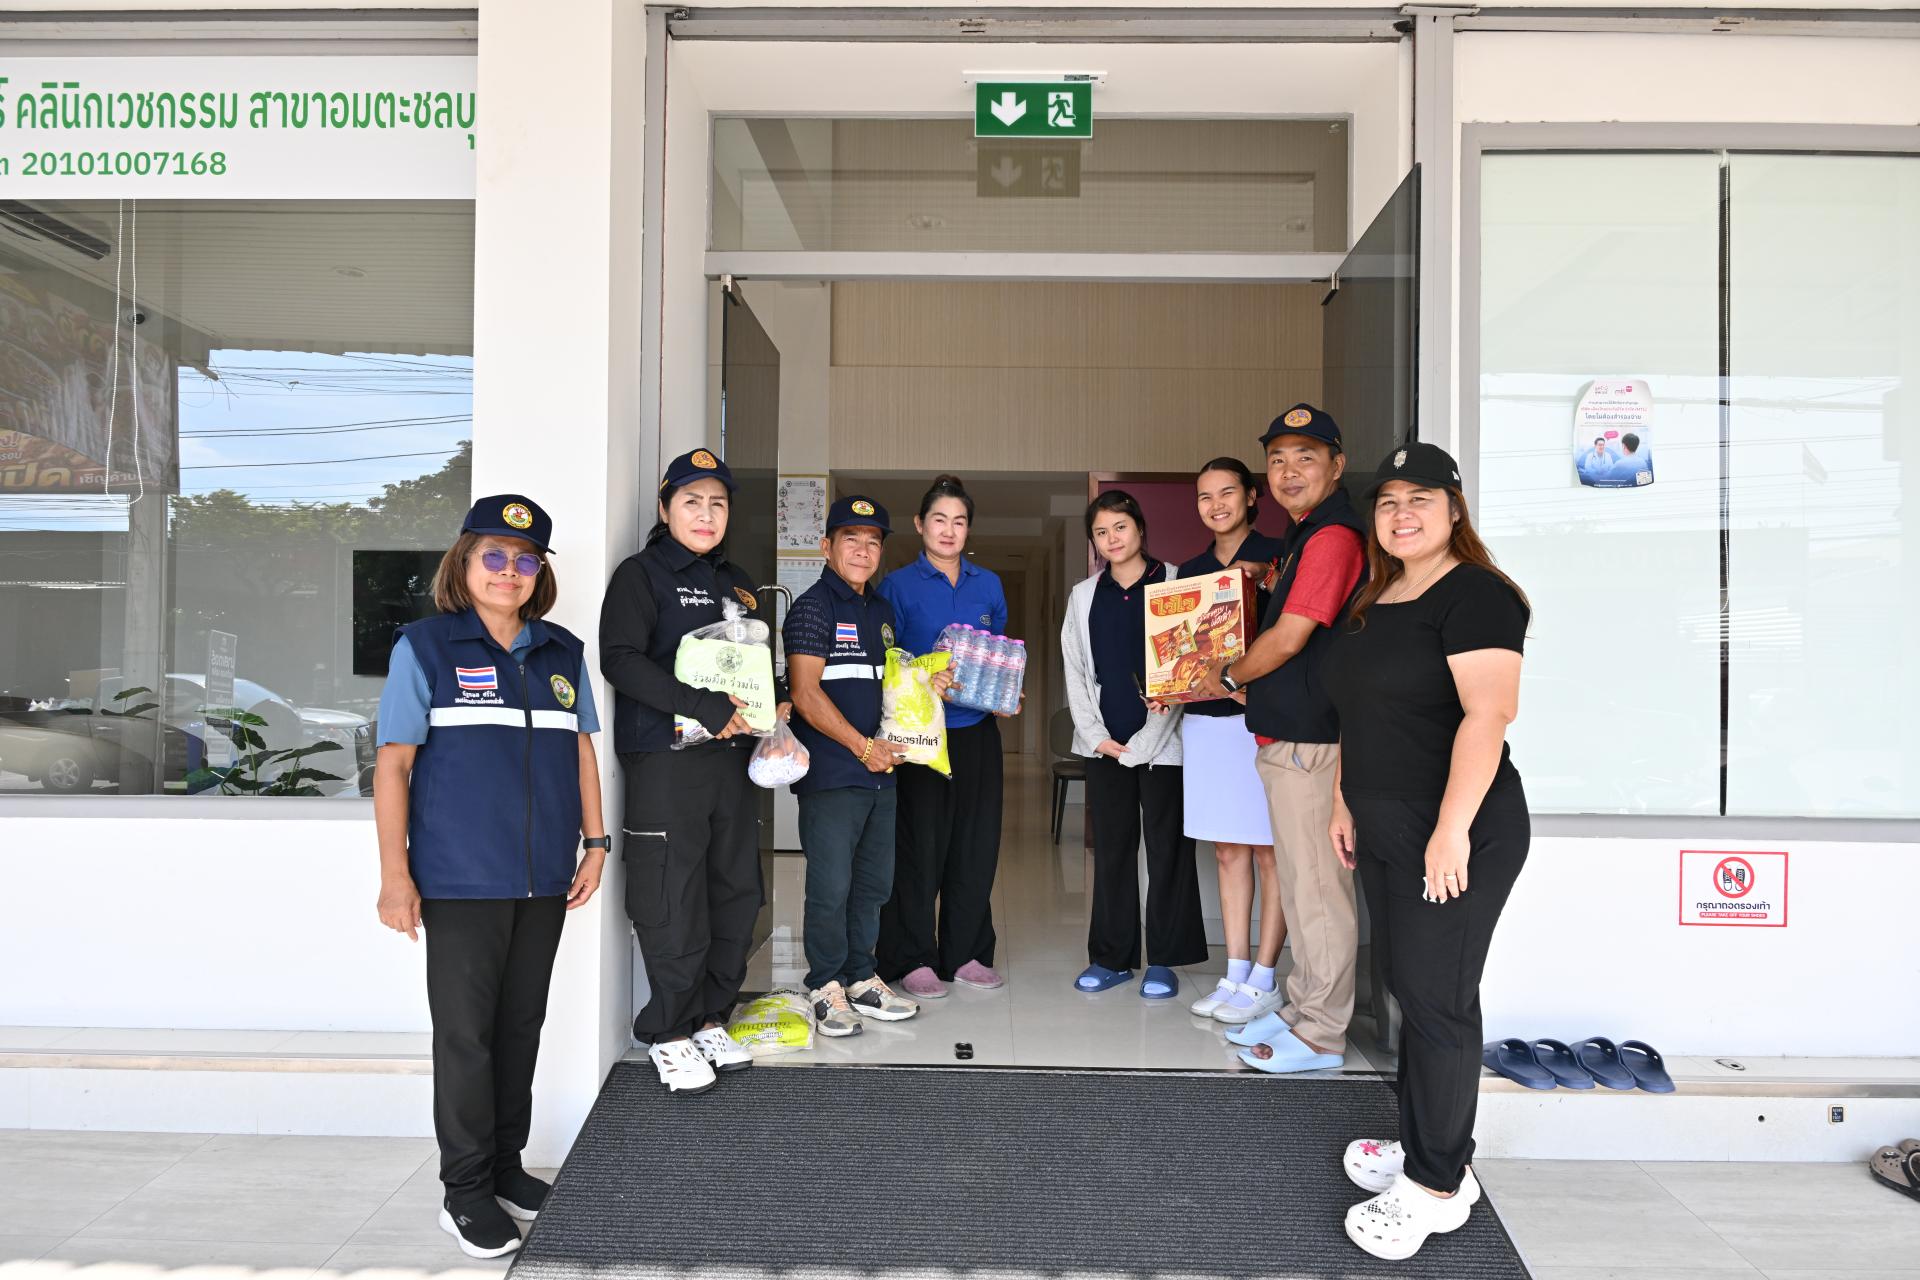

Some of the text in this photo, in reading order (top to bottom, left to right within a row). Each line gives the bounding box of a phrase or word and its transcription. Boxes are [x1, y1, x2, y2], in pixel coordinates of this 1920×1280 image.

[17, 82, 238, 129] คลินิกเวชกรรม
[22, 151, 227, 177] 20101007168
[887, 732, 939, 747] ข้าวตราไก่แจ้
[1696, 901, 1771, 912] กรุณาถอดรองเท้า
